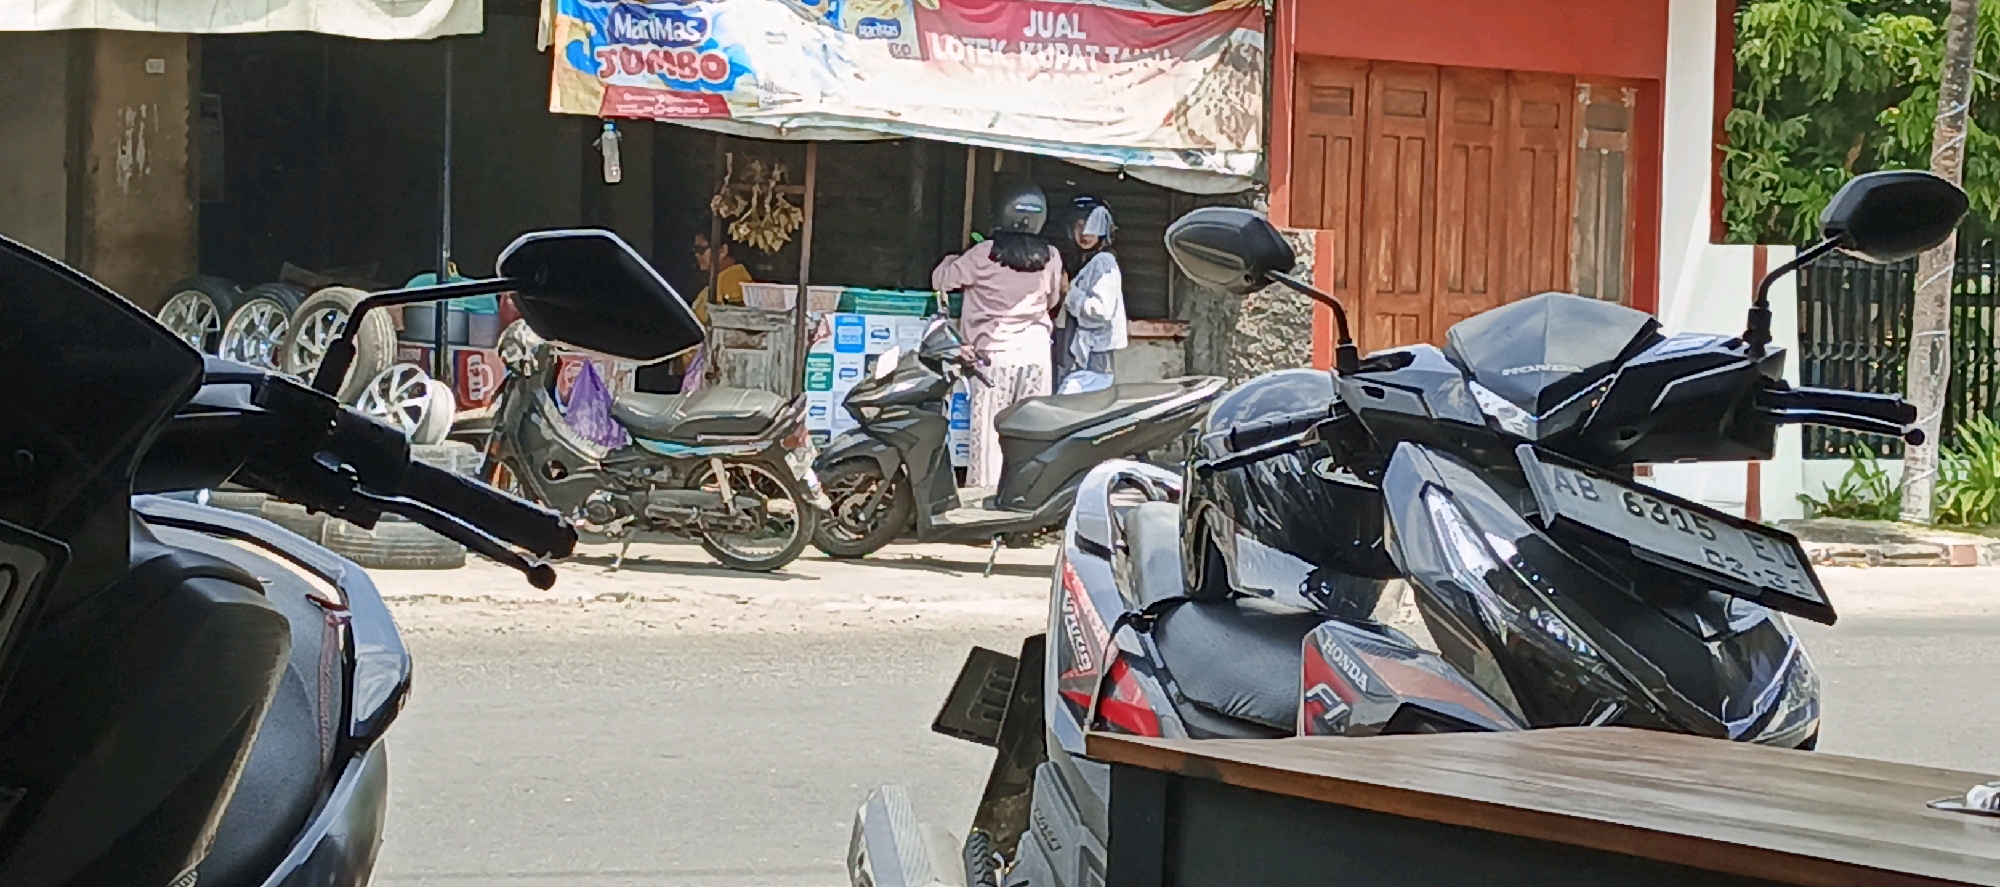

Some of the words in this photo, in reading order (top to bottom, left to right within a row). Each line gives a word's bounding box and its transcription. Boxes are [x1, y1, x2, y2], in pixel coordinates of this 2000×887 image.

[1023, 8, 1087, 40] JUAL
[596, 46, 730, 81] JUMBO
[1019, 41, 1100, 72] KUPAT
[1501, 362, 1585, 377] HONDA
[1553, 466, 1601, 503] AB
[1622, 491, 1717, 542] 6315
[1322, 637, 1369, 692] HONDA
